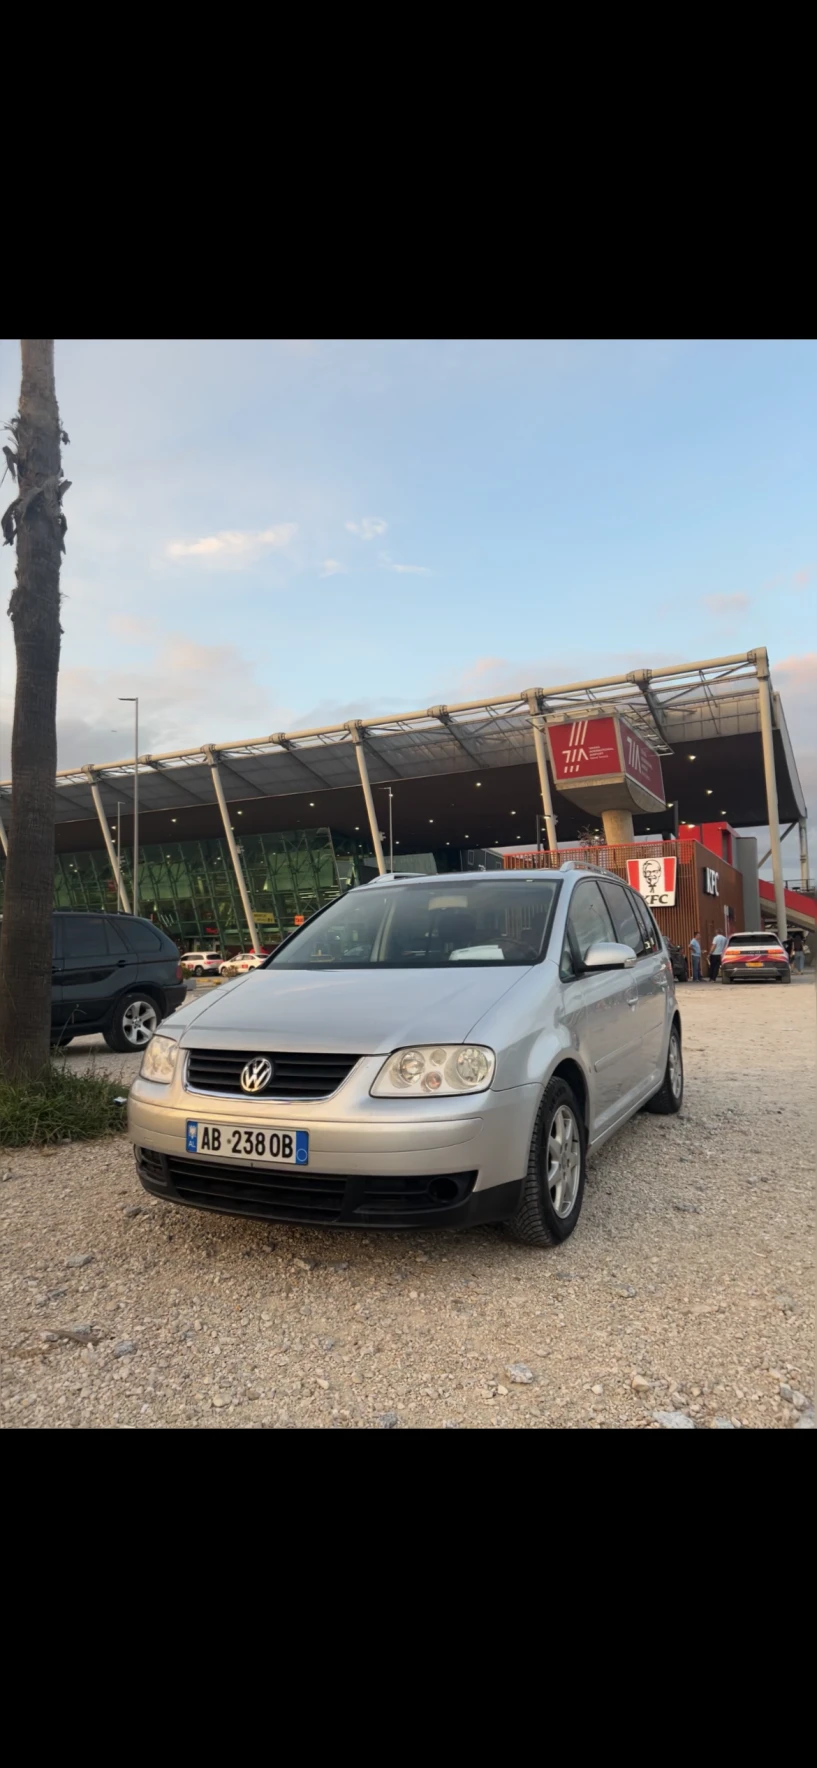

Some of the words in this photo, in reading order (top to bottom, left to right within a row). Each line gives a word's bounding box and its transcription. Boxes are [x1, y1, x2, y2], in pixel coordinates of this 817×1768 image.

[706, 867, 719, 897] KFC
[188, 1140, 196, 1148] AL
[201, 1127, 221, 1151] AB
[231, 1130, 266, 1156] 238
